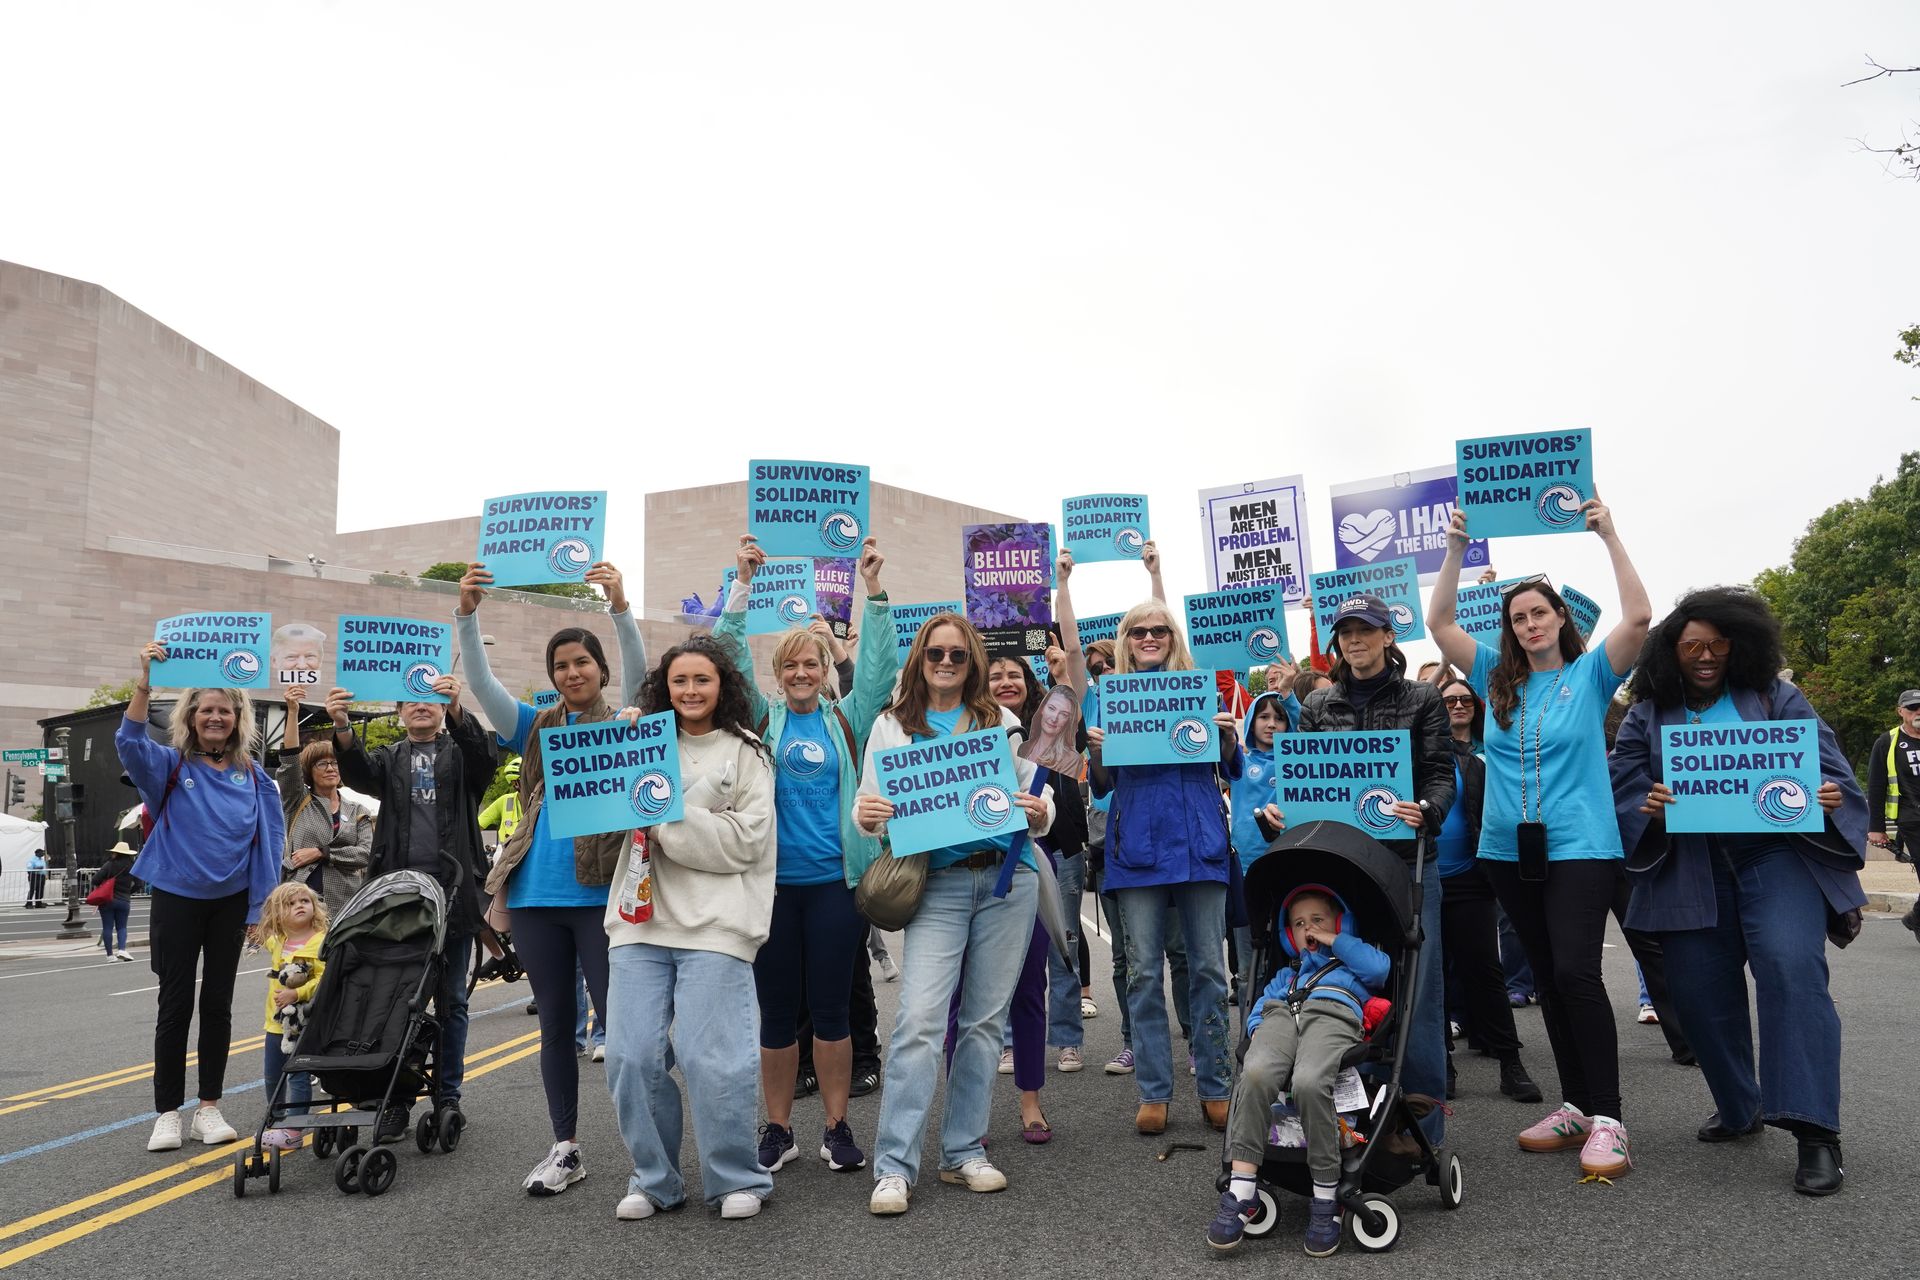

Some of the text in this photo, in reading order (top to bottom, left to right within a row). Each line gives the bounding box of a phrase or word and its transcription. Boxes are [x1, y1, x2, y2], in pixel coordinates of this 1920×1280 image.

[1462, 434, 1582, 460] SURVIVORS'
[755, 465, 861, 484] SURVIVORS'
[1463, 459, 1581, 483] SOLIDARITY
[755, 487, 859, 505] SOLIDARITY
[1066, 496, 1142, 512] SURVIVORS'
[1464, 487, 1531, 505] MARCH
[487, 496, 598, 516] SURVIVORS'
[1229, 499, 1277, 522] MEN
[755, 509, 817, 523] MARCH
[1066, 512, 1142, 527] SOLIDARITY
[1231, 516, 1279, 534] ARE THE
[1399, 509, 1409, 538] I
[485, 517, 594, 536] SOLIDARITY
[1067, 528, 1112, 542] MARCH
[482, 538, 546, 556] MARCH
[1218, 526, 1295, 552] PROBLEM.
[1395, 534, 1448, 554] THE RIG
[974, 549, 1041, 570] BELIEVE
[1233, 547, 1282, 570] MEN
[815, 569, 850, 584] ELIEVE
[973, 569, 1043, 587] SURVIVORS
[1226, 563, 1293, 583] MUST BE THE
[1315, 563, 1409, 590] SURVIVORS'
[1188, 589, 1276, 611] SURVIVORS'
[161, 616, 264, 631] SURVIVORS'
[1190, 607, 1276, 629] SOLIDARITY
[344, 620, 445, 639] SURVIVORS'
[1192, 630, 1242, 646] MARCH
[343, 640, 442, 657] SOLIDARITY
[342, 659, 401, 673] MARCH
[280, 670, 318, 684] LIES
[1105, 675, 1208, 694] SURVIVORS'
[1106, 696, 1207, 715] SOLIDARITY
[548, 718, 667, 752] SURVIVORS'
[1107, 719, 1166, 735] MARCH
[1280, 736, 1401, 756] SURVIVORS'
[1669, 726, 1806, 748] SURVIVORS'
[551, 743, 668, 777] SOLIDARITY
[881, 733, 998, 772] SURVIVORS'
[1670, 751, 1805, 772] SOLIDARITY
[886, 757, 1001, 796] SOLIDARITY
[1281, 761, 1400, 780] SOLIDARITY
[553, 776, 626, 801] MARCH
[1283, 786, 1351, 802] MARCH
[1671, 778, 1749, 796] MARCH
[892, 791, 961, 820] MARCH
